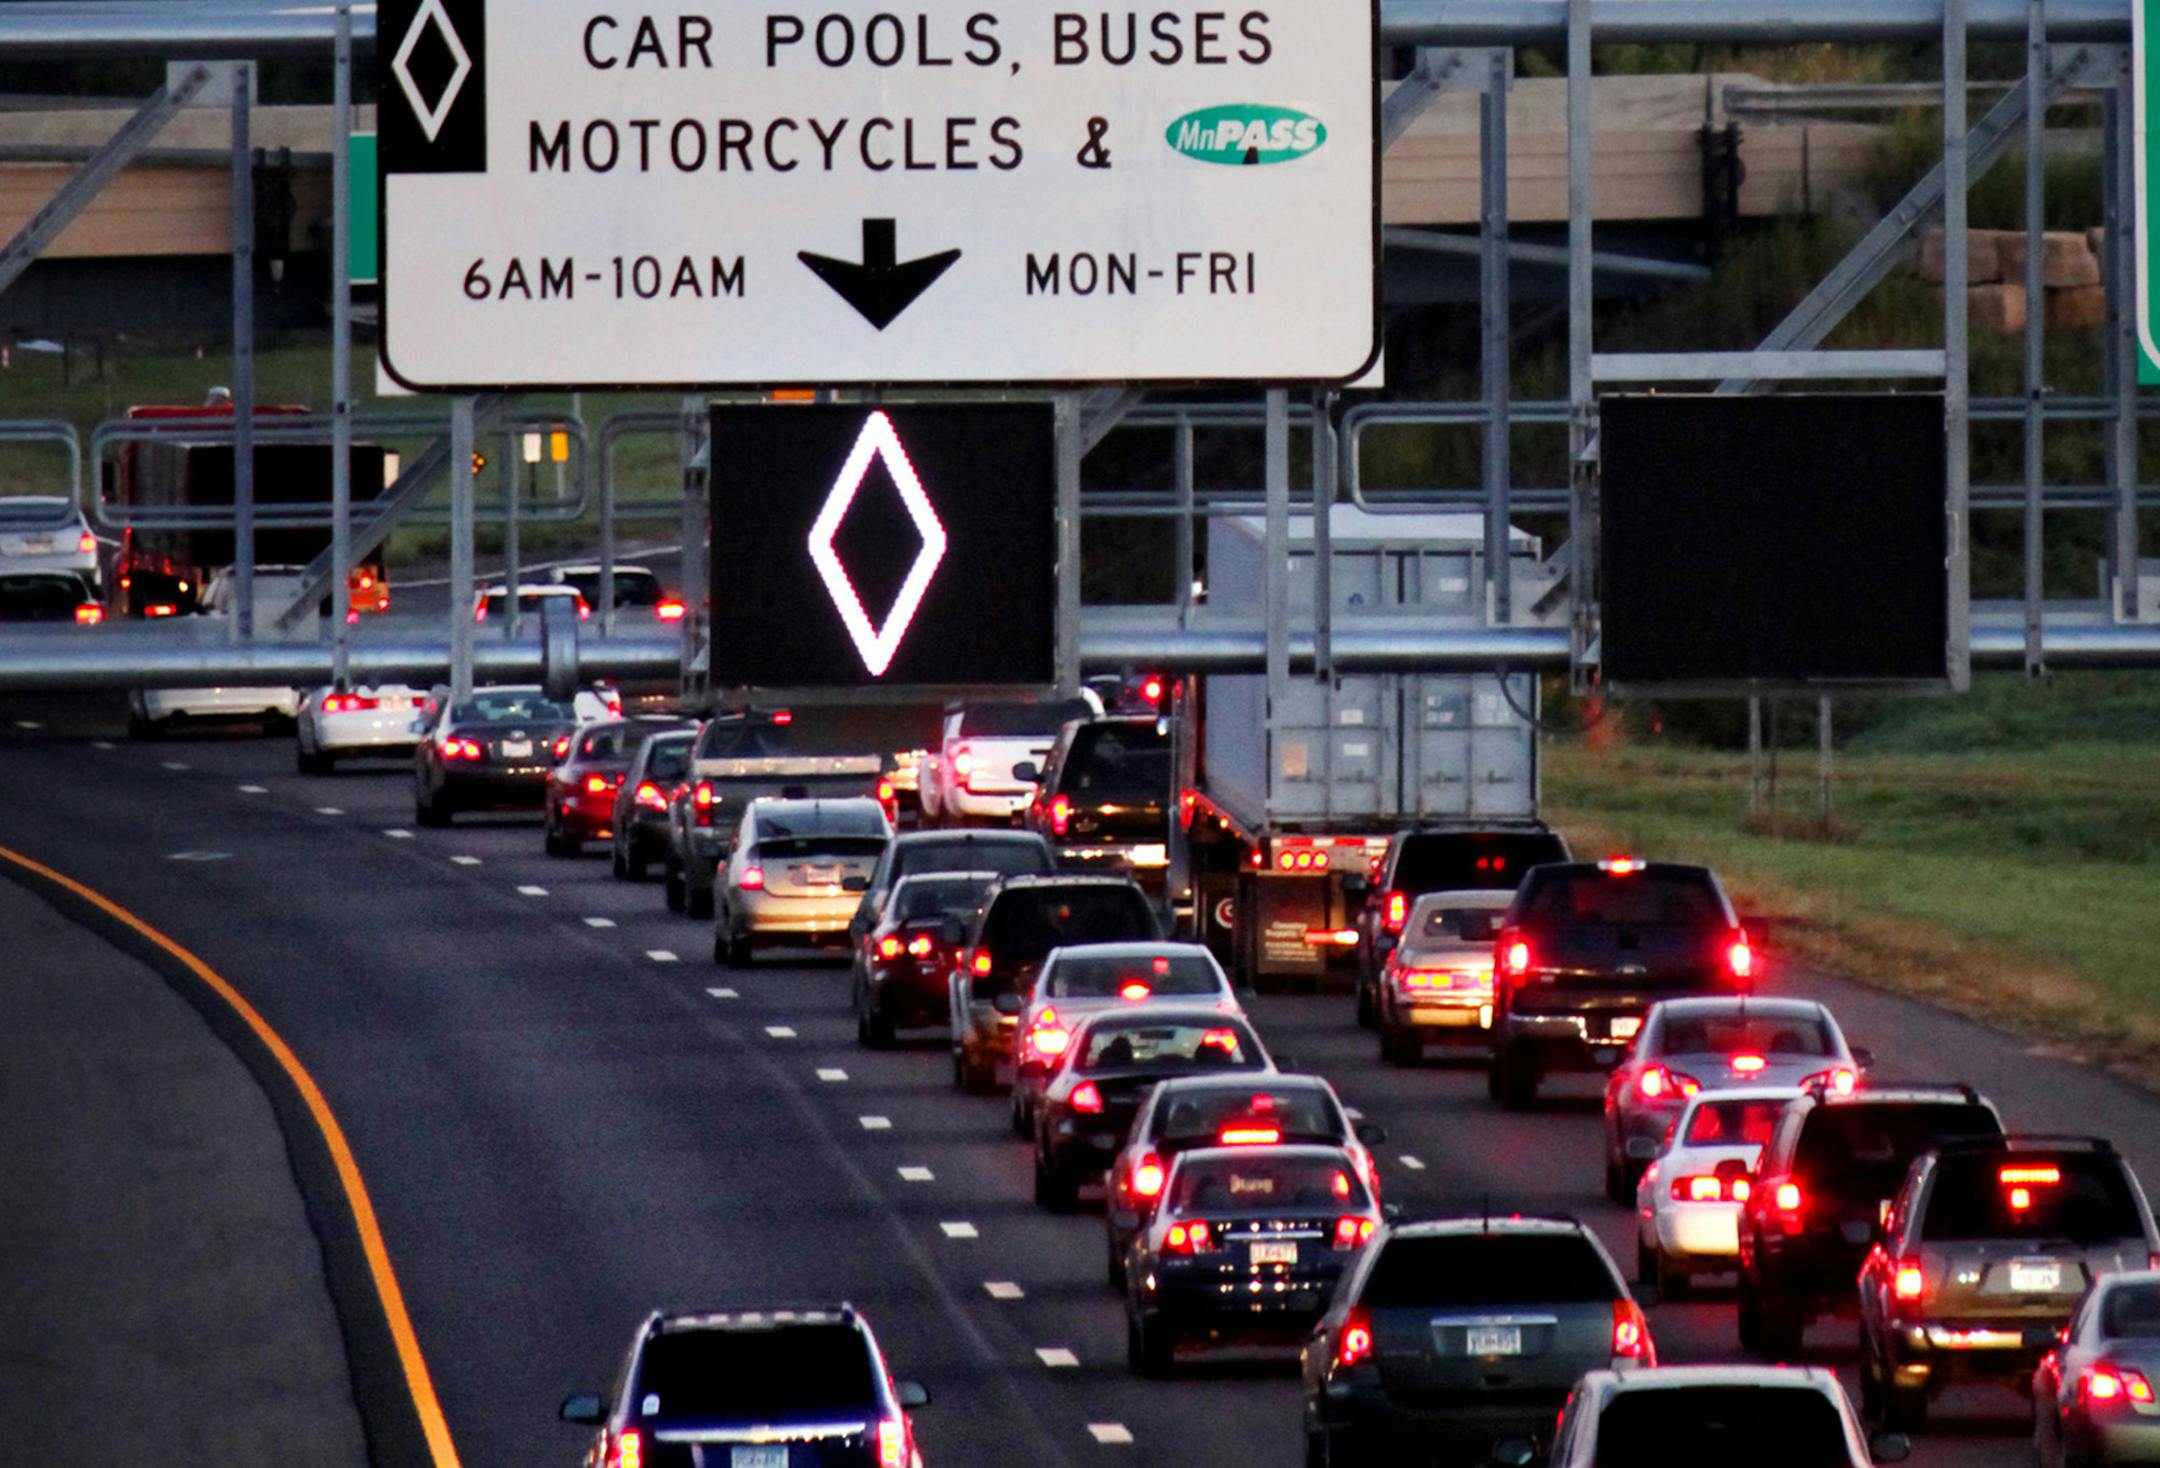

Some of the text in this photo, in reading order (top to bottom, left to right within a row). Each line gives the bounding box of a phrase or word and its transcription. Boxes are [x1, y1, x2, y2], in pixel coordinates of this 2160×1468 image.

[583, 10, 1273, 77] CAR POOLS, BUSES
[529, 116, 1321, 174] MOTORCYCLES & MnPASS
[463, 252, 1254, 301] 6AM-10AM MON-FRI
